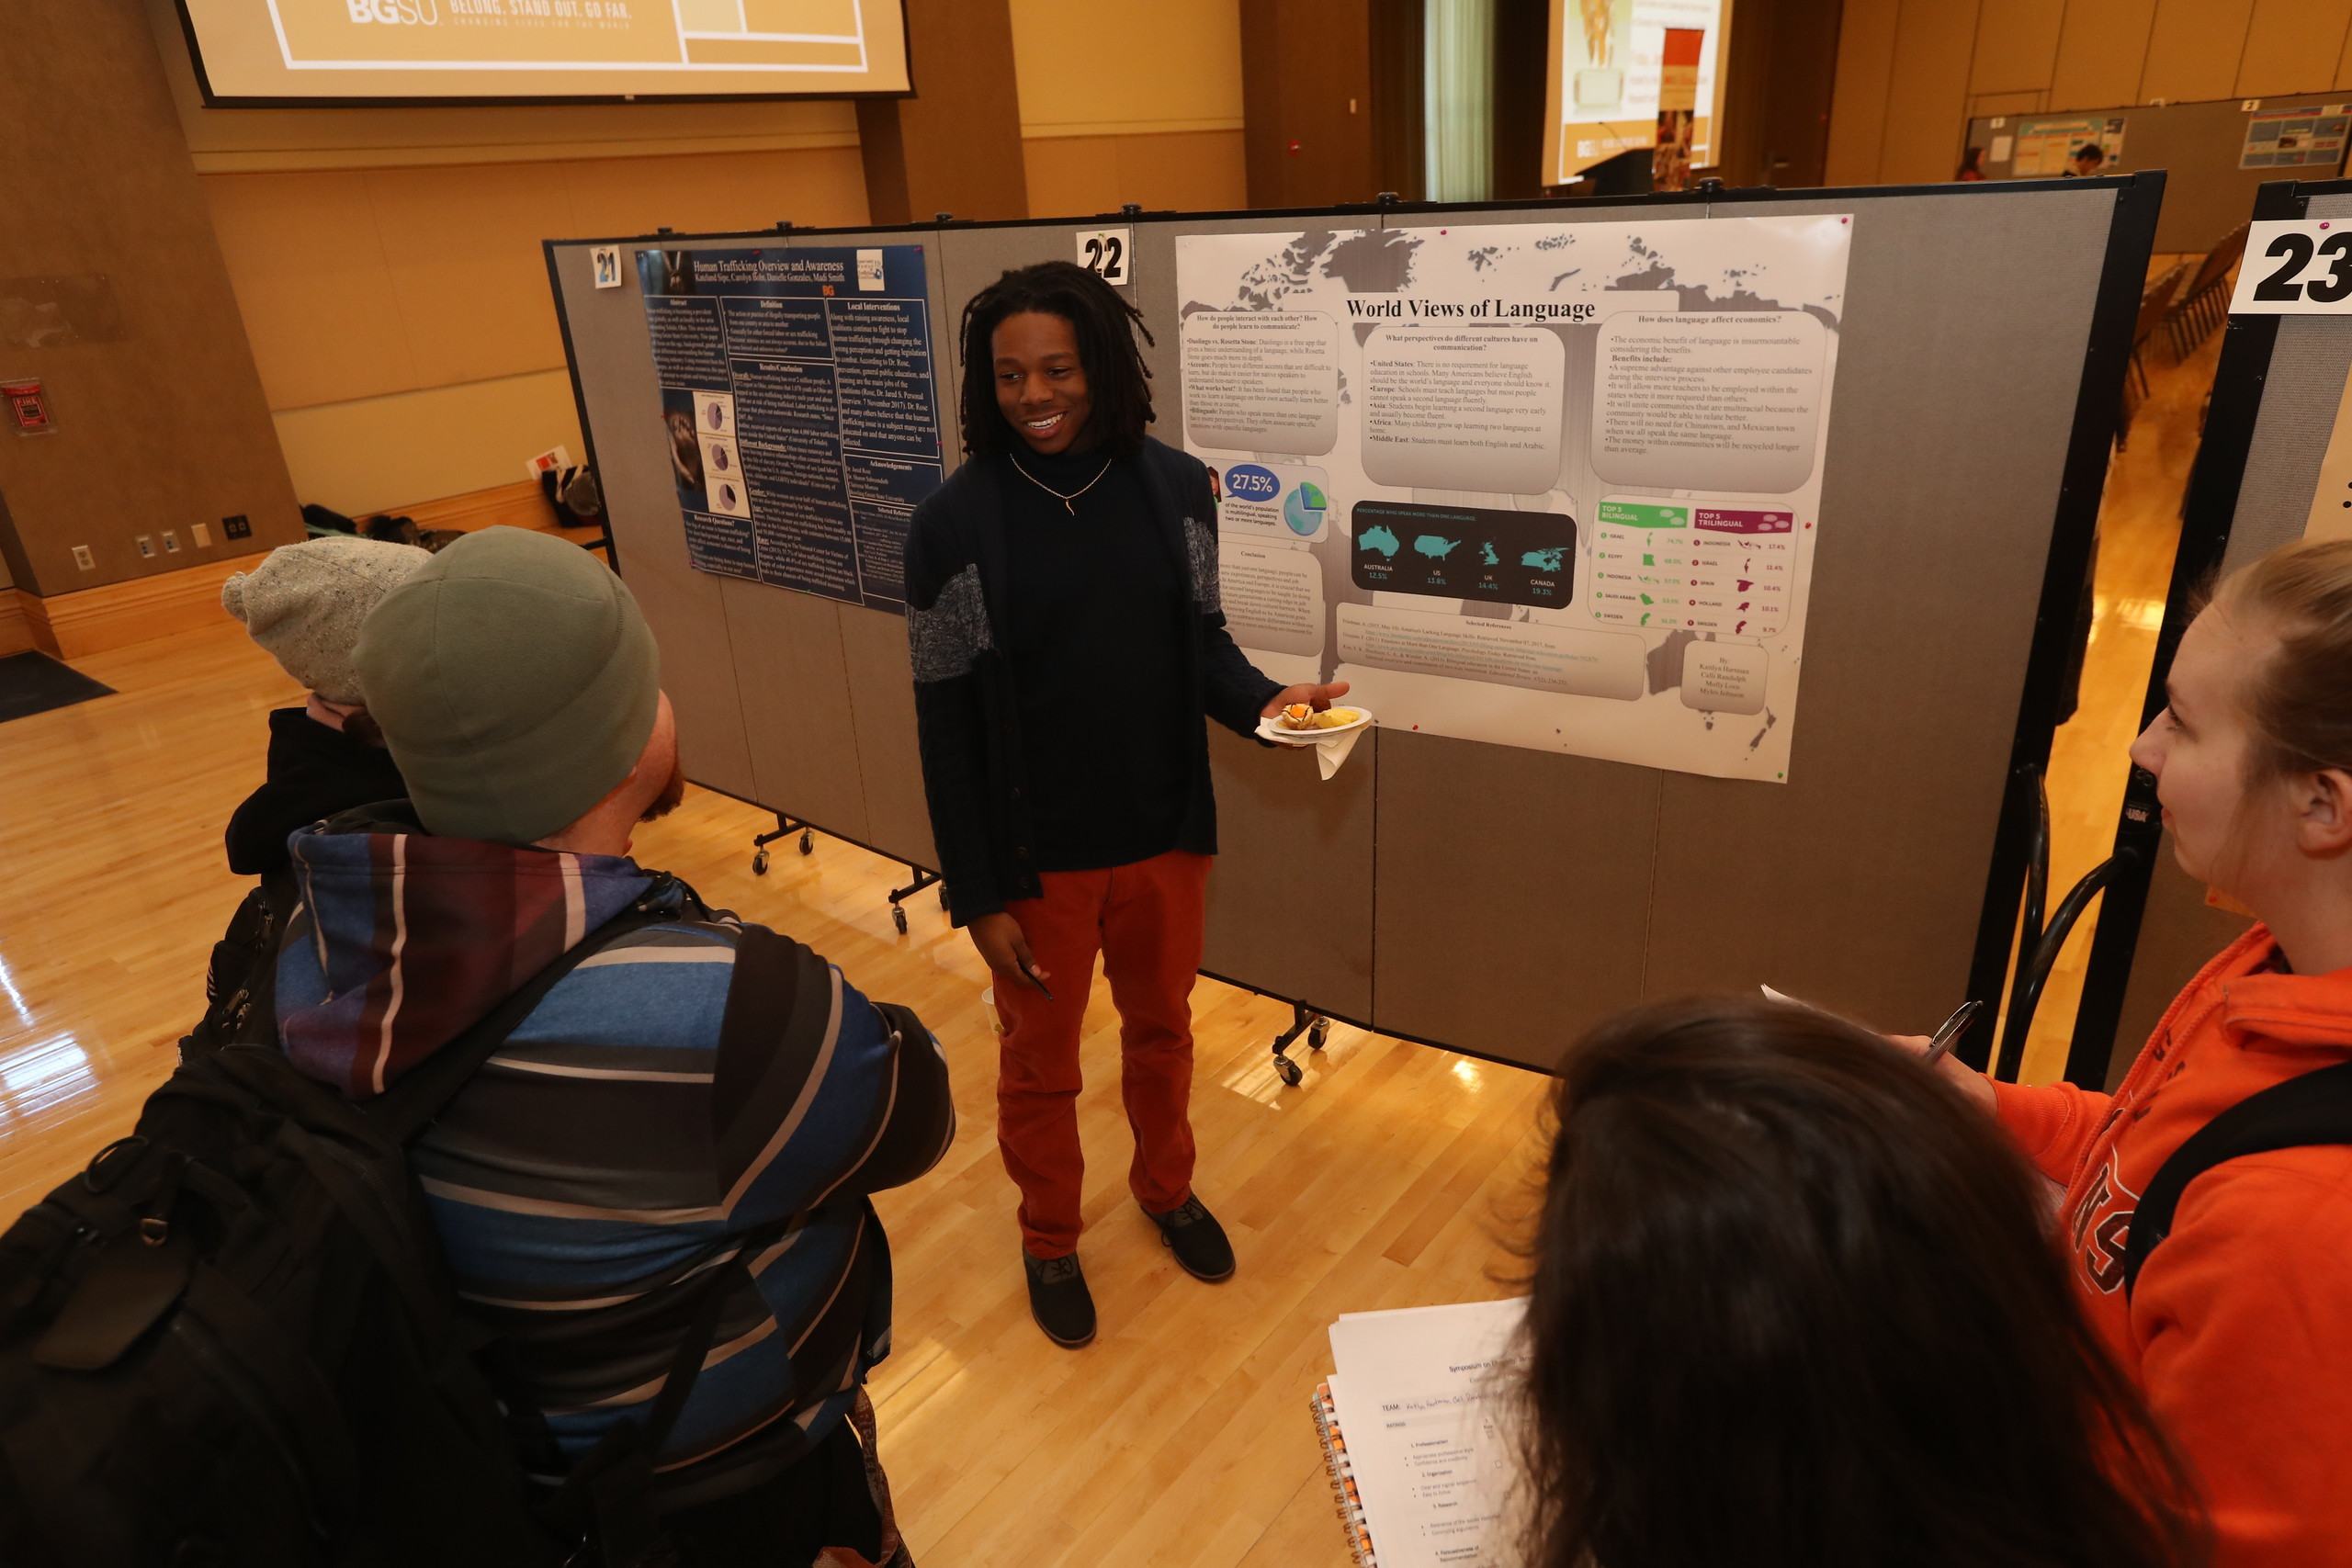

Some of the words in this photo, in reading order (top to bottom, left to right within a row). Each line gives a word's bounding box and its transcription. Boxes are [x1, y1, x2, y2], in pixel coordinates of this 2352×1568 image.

[347, 0, 438, 25] BGSU
[450, 0, 506, 15] BELONG.
[511, 0, 550, 16] STAND
[555, 0, 583, 17] OUT.
[584, 1, 602, 17] GO
[606, 2, 632, 19] FAR.
[1085, 237, 1122, 277] 22
[597, 252, 616, 282] 21
[694, 260, 718, 272] Human
[718, 260, 758, 274] Trafficking
[758, 260, 790, 272] Overview
[791, 260, 804, 272] and
[806, 260, 844, 272] Awareness
[2253, 231, 2352, 302] 23
[847, 302, 864, 310] Local
[864, 302, 900, 311] Interventions
[1346, 299, 1401, 318] World
[1408, 299, 1464, 318] Views
[1470, 299, 1490, 318] of
[1496, 299, 1595, 322] Language
[1675, 316, 1709, 324] language
[1233, 474, 1272, 492] 27.5%
[1601, 512, 1638, 521] BILINGUAL
[1698, 519, 1743, 527] TRILINGUAL
[1240, 550, 1266, 559] Conclusion
[1363, 563, 1393, 572] AUSTRALIA
[1530, 579, 1555, 588] CANADA
